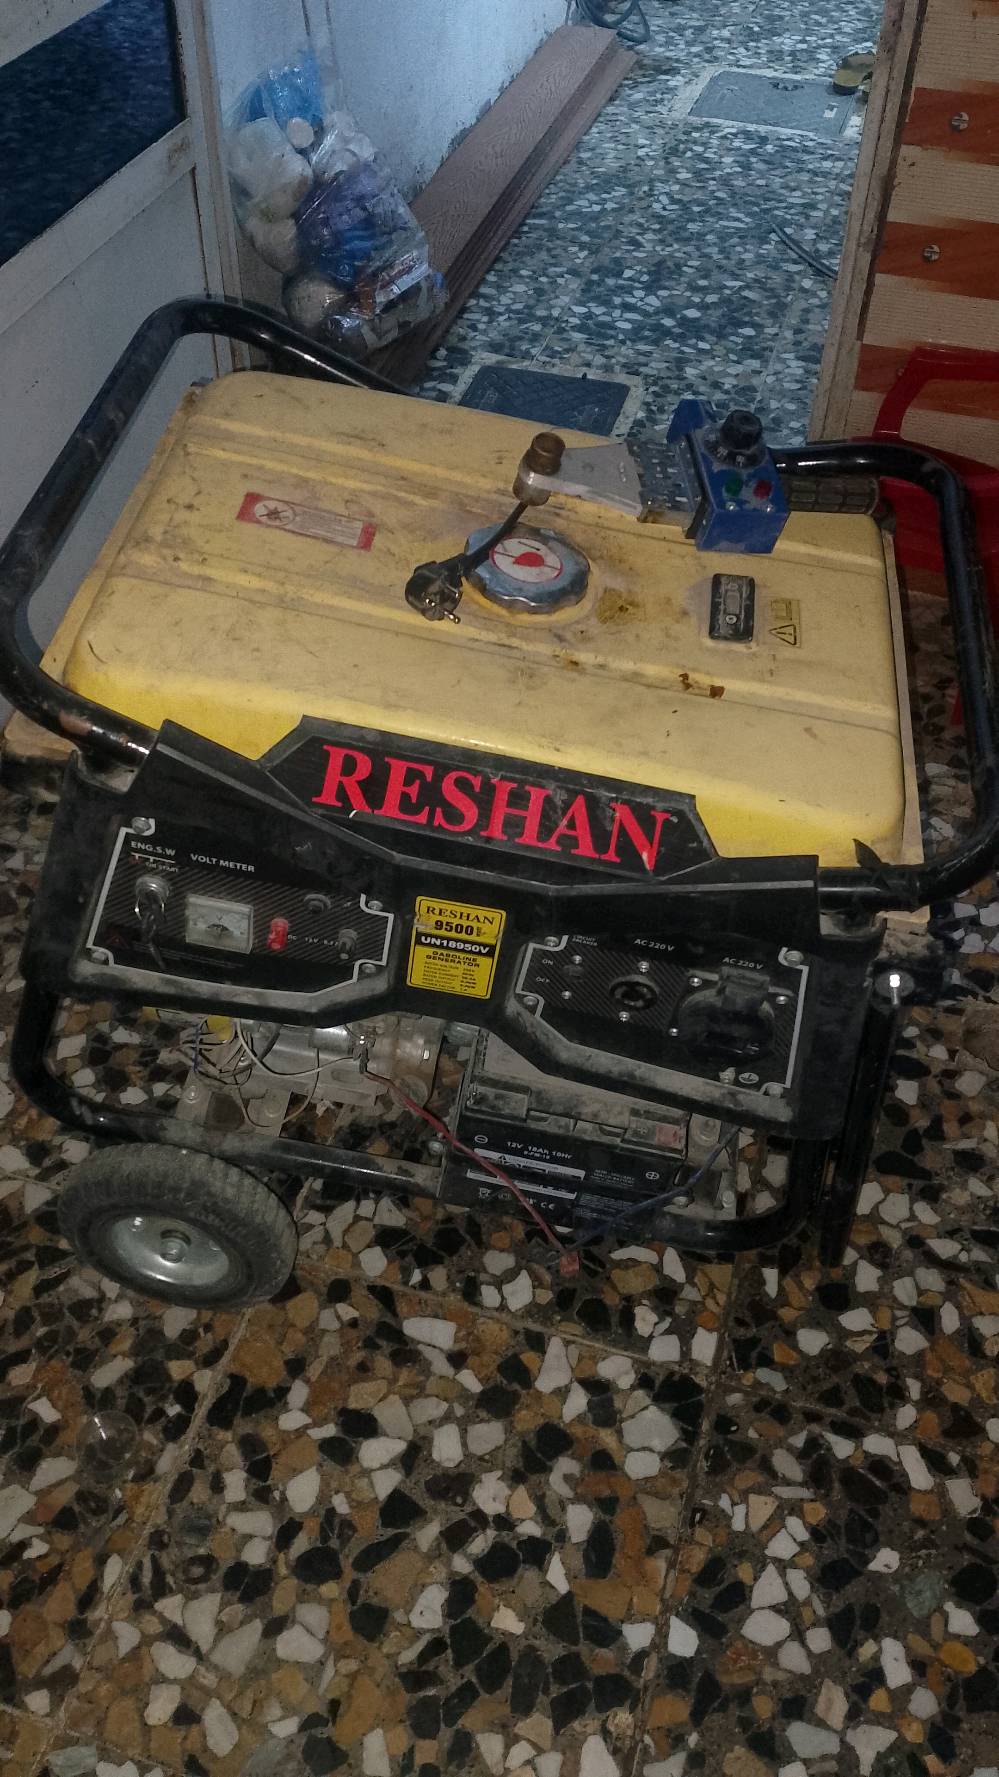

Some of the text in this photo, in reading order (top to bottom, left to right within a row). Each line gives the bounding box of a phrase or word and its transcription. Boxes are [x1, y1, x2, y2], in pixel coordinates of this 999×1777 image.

[312, 745, 672, 872] RESHAN
[130, 840, 176, 857] ENG.S.W
[190, 852, 255, 873] VOLT METER
[426, 905, 495, 926] RESHAN
[434, 919, 475, 936] 9500
[633, 938, 647, 946] AC
[648, 942, 666, 950] 220
[425, 954, 481, 969] GENERATOR
[432, 950, 479, 963] GASOLINE
[722, 957, 735, 965] AC
[736, 960, 755, 968] 220
[506, 1141, 524, 1149] 12V
